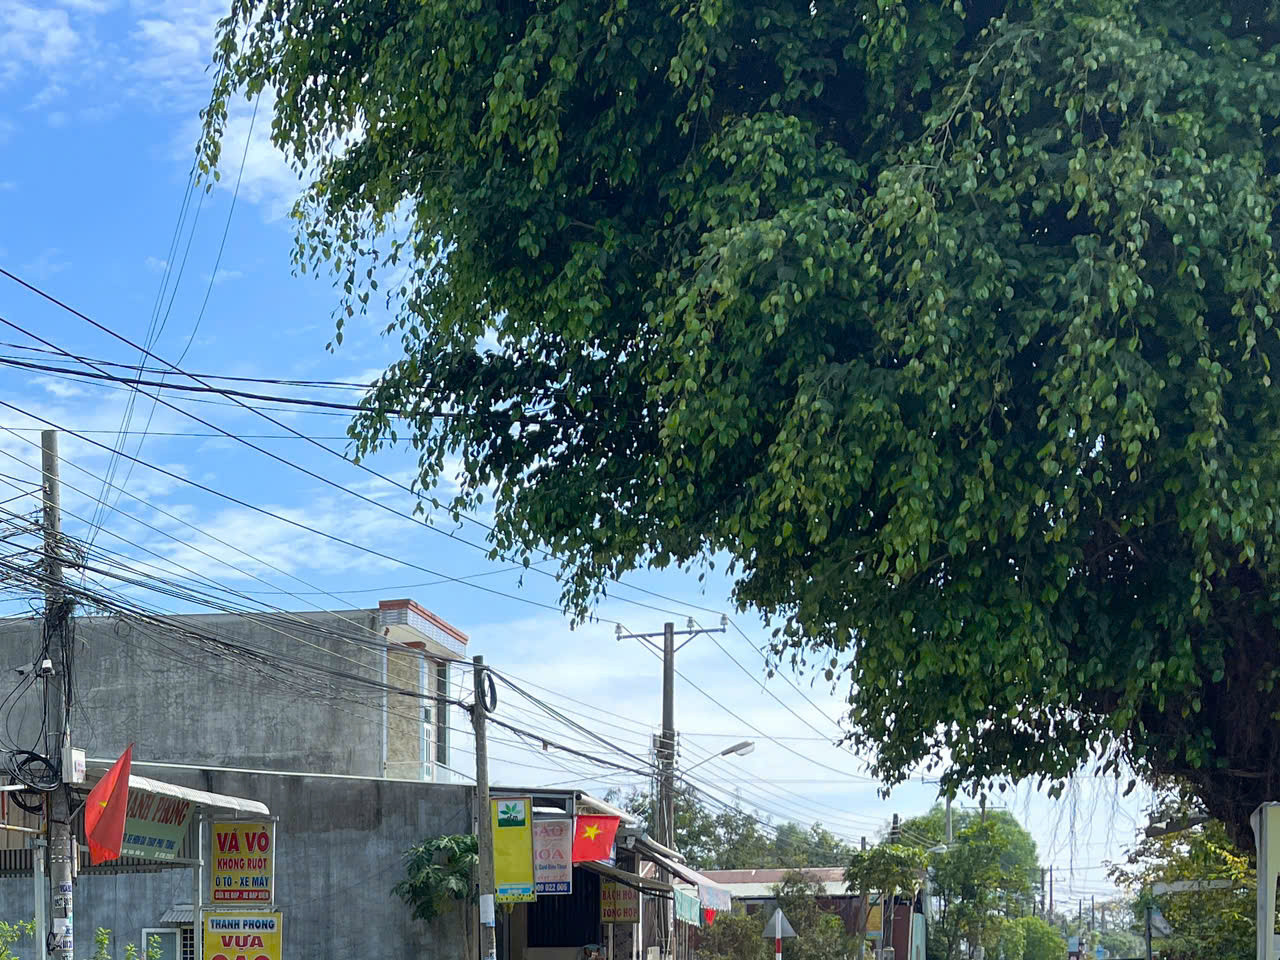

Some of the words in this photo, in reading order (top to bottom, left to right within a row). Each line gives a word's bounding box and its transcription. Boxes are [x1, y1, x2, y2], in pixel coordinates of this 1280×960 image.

[245, 826, 270, 853] VỎ
[239, 876, 250, 888] XE
[210, 919, 240, 930] THANH
[243, 919, 275, 931] PHONG
[221, 934, 264, 950] VỰA
